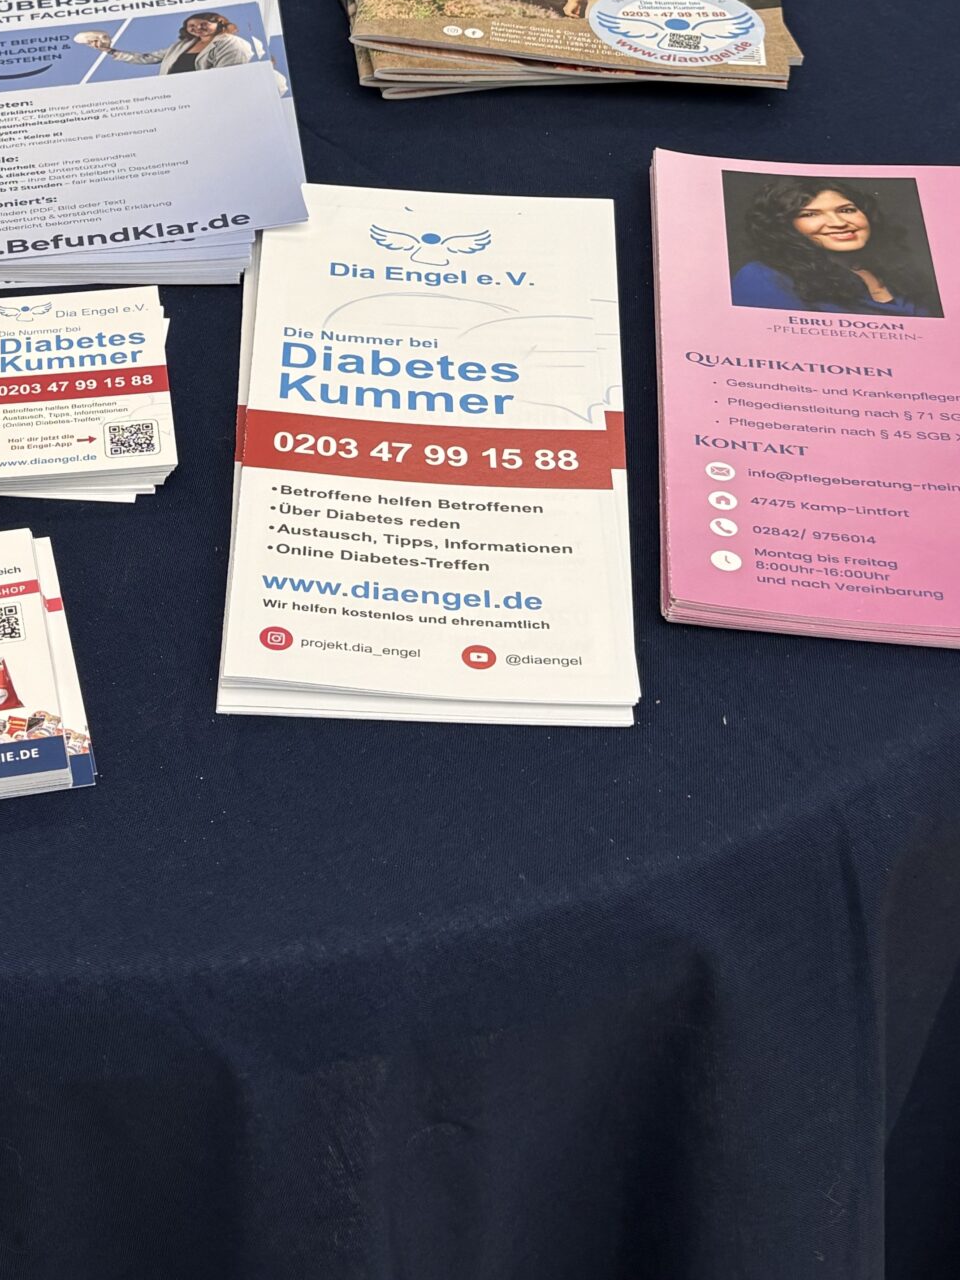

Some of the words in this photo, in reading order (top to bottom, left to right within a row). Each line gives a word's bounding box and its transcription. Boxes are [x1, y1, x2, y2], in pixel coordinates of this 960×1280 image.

[10, 35, 70, 47] BEFUND
[616, 39, 752, 62] www.diaengel.de
[330, 262, 375, 279] Dia
[385, 267, 467, 286] Engel
[55, 310, 77, 318] Dia
[82, 306, 119, 316] Engel
[123, 304, 148, 313] e.V.
[0, 330, 146, 355] Diabetes
[18, 327, 62, 336] Nummer
[283, 327, 314, 340] Die
[321, 330, 402, 347] Nummer
[409, 335, 438, 348] bei
[0, 349, 143, 373] Kummer
[281, 342, 520, 383] Diabetes
[686, 351, 893, 378] QUALIFIKATIONEN
[47, 382, 69, 392] 47
[75, 379, 97, 391] 99
[104, 376, 125, 388] 15
[131, 374, 153, 386] 88
[279, 372, 515, 415] Kummer
[726, 379, 817, 394] Gesundheits-
[822, 386, 848, 396] und
[3, 413, 45, 421] Austausch,
[74, 407, 129, 416] Informationen
[72, 401, 117, 410] Betroffenen
[728, 397, 860, 417] Pflegedienstleitung
[864, 409, 898, 419] nach
[904, 410, 912, 421] §
[918, 411, 933, 420] 71
[2, 421, 34, 429] (Online)
[36, 417, 101, 426] Diabetes-Treffen
[729, 417, 836, 434] Pflegeberaterin
[841, 428, 875, 438] nach
[880, 429, 888, 440] §
[894, 430, 912, 439] 45
[916, 431, 951, 441] SGB
[273, 431, 359, 459] 0203
[370, 441, 413, 463] 47
[424, 445, 468, 466] 99
[482, 447, 523, 469] 15
[534, 448, 579, 471] 88
[694, 434, 808, 456] KONTAKT
[748, 469, 960, 492] info@pflegeberatung-rhein
[280, 485, 372, 504] Betroffene
[378, 494, 432, 509] helfen
[439, 498, 543, 515] Betroffenen
[750, 496, 796, 508] 47475
[800, 502, 910, 518] Kamp-Lintfort
[279, 503, 321, 518] Über
[326, 508, 403, 526] Diabetes
[410, 516, 460, 530] reden
[277, 523, 377, 544] Austausch,
[384, 534, 439, 550] Tipps,
[445, 538, 573, 554] Informationen
[752, 525, 806, 540] 02842/
[812, 530, 876, 544] 9756014
[276, 544, 334, 560] Online
[340, 550, 490, 572] Diabetes-Treffen
[754, 548, 812, 564] Montag
[817, 554, 840, 564] bis
[844, 556, 898, 570] Freitag
[756, 560, 890, 581] 8:00Uhr-16:00Uhr
[262, 575, 543, 611] www.diaengel.de
[757, 575, 786, 585] und
[792, 578, 830, 590] nach
[835, 582, 944, 600] Vereinbarung
[263, 599, 288, 610] Wir
[292, 601, 337, 615] helfen
[342, 607, 414, 622] kostenlos
[419, 615, 447, 625] und
[451, 616, 550, 630] ehrenamtlich
[301, 638, 421, 659] projekt.dia_engel
[505, 653, 582, 667] @diaengel
